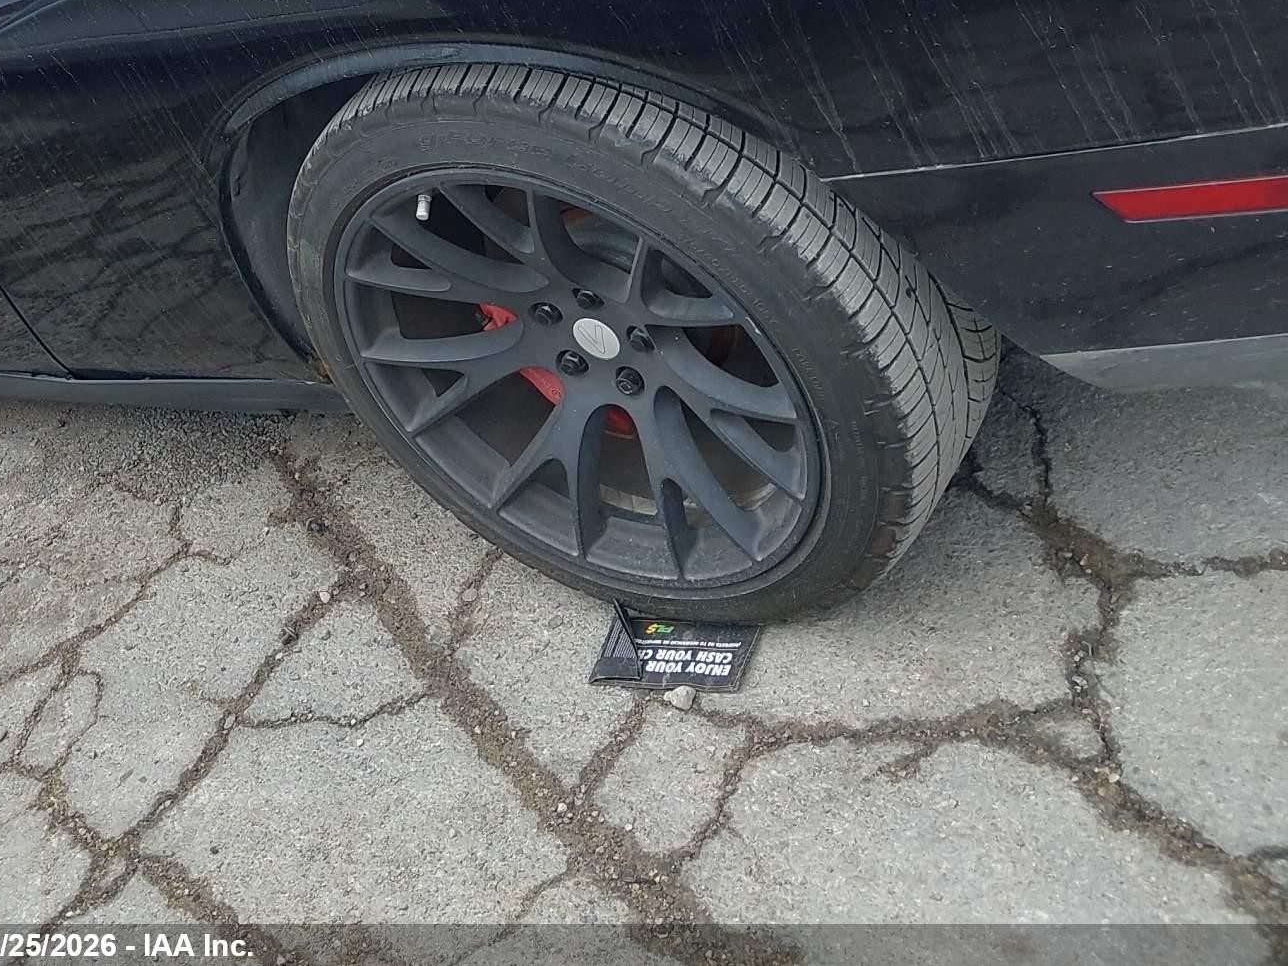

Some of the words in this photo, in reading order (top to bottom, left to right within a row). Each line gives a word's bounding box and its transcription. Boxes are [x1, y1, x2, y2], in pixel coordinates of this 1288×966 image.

[655, 649, 693, 661] YOUR
[695, 651, 733, 664] CASH
[646, 661, 685, 673] YOUR
[685, 662, 732, 676] ENJOY
